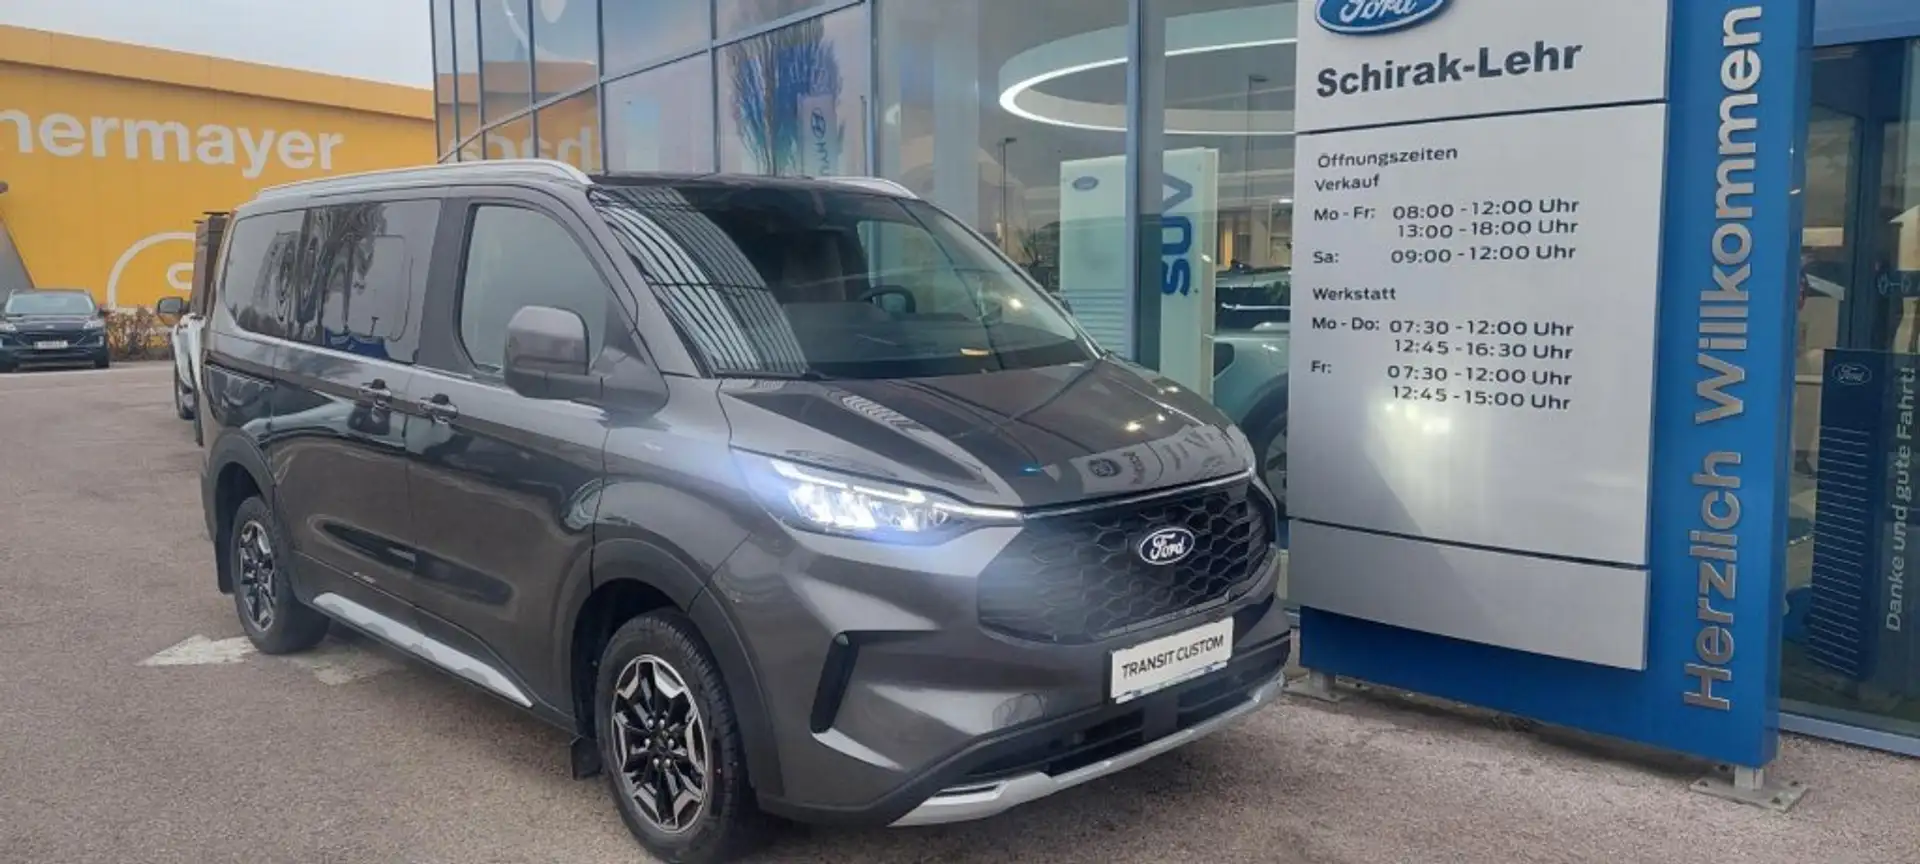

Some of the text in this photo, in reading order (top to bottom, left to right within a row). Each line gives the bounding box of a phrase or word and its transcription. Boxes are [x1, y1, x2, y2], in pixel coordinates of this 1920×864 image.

[1316, 40, 1583, 98] Schirak-Lehr
[1317, 147, 1458, 169] Öffnungszeiten
[1314, 174, 1380, 192] Verkauf
[1313, 208, 1339, 221] Mo
[1353, 206, 1376, 220] Fr:
[1392, 203, 1454, 220] 08:00
[1472, 200, 1533, 216] 12:00
[1539, 198, 1579, 214] Uhr
[1161, 172, 1194, 297] SUV
[1398, 224, 1453, 239] 13:00
[1472, 220, 1532, 236] 18:00
[1538, 218, 1579, 234] Uhr
[1312, 250, 1339, 264] Sa:
[1391, 249, 1452, 264] 09:00
[1470, 245, 1530, 261] 12:00
[1536, 244, 1576, 260] Uhr
[1312, 287, 1397, 301] Werkstatt
[1312, 317, 1337, 330] Mo
[1351, 316, 1380, 331] Do:
[1389, 319, 1449, 335] 07:30
[1467, 320, 1527, 336] 12:00
[1533, 321, 1574, 337] Uhr
[1394, 339, 1449, 355] 12:45
[1467, 342, 1527, 359] 16:30
[1533, 344, 1573, 360] Uhr
[1683, 5, 1763, 711] Herzlich Willkommen
[1310, 360, 1331, 374] Fr:
[1387, 365, 1448, 381] 07:30
[1466, 367, 1526, 384] 12:00
[1531, 370, 1573, 386] Uhr
[1392, 385, 1447, 402] 12:45
[1464, 390, 1525, 407] 15:00
[1530, 393, 1572, 410] Uhr
[1886, 366, 1916, 633] Danke und gute Fahrt!
[1121, 634, 1224, 679] TRANSIT CUSTOM
